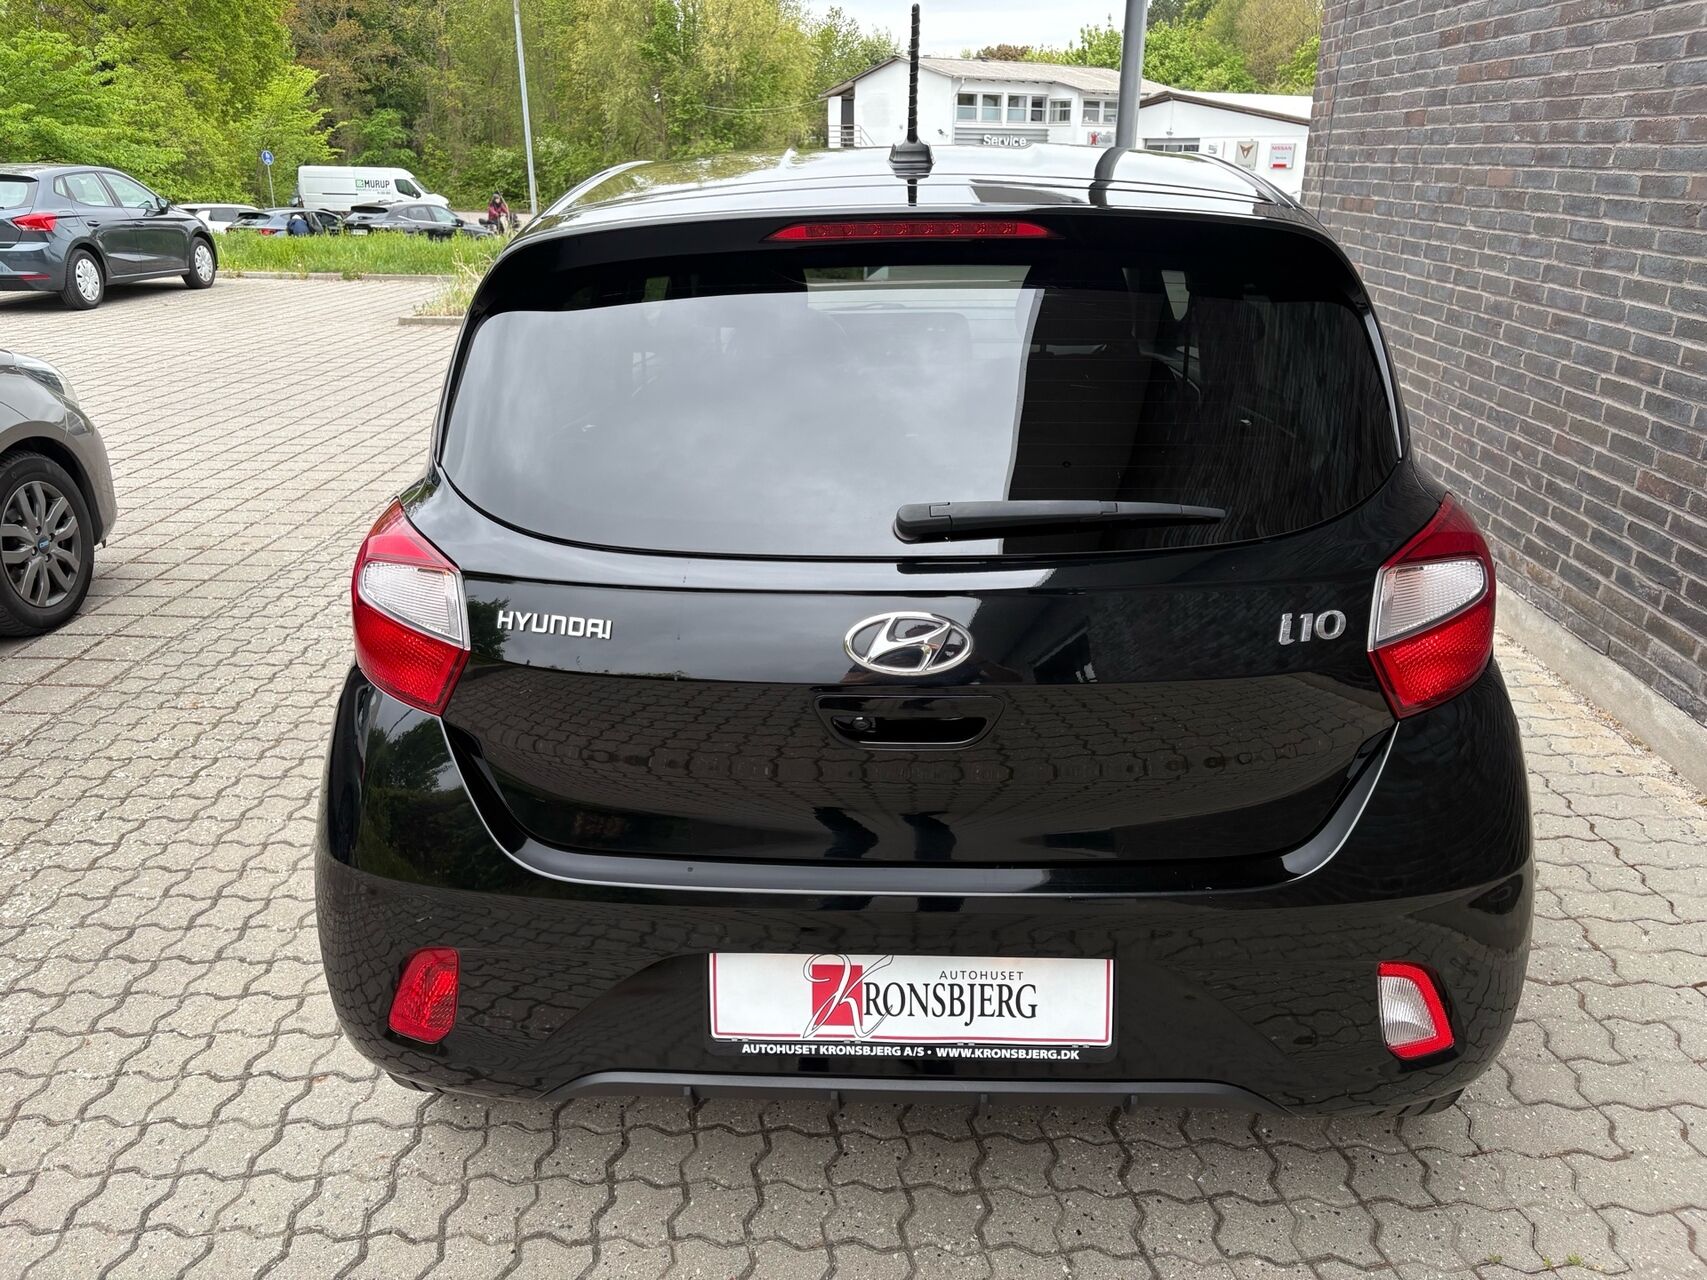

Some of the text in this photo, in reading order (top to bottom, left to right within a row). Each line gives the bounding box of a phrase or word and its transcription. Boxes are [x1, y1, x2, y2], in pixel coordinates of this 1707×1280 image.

[983, 134, 1027, 147] Service
[497, 610, 613, 640] HYUNDAI
[1278, 609, 1347, 646] i10
[939, 970, 1024, 981] AUTOHUSET
[741, 1043, 1080, 1060] AUTOHUSET KRONSBJERG A/S WWW.KRONSBJERG.DK
